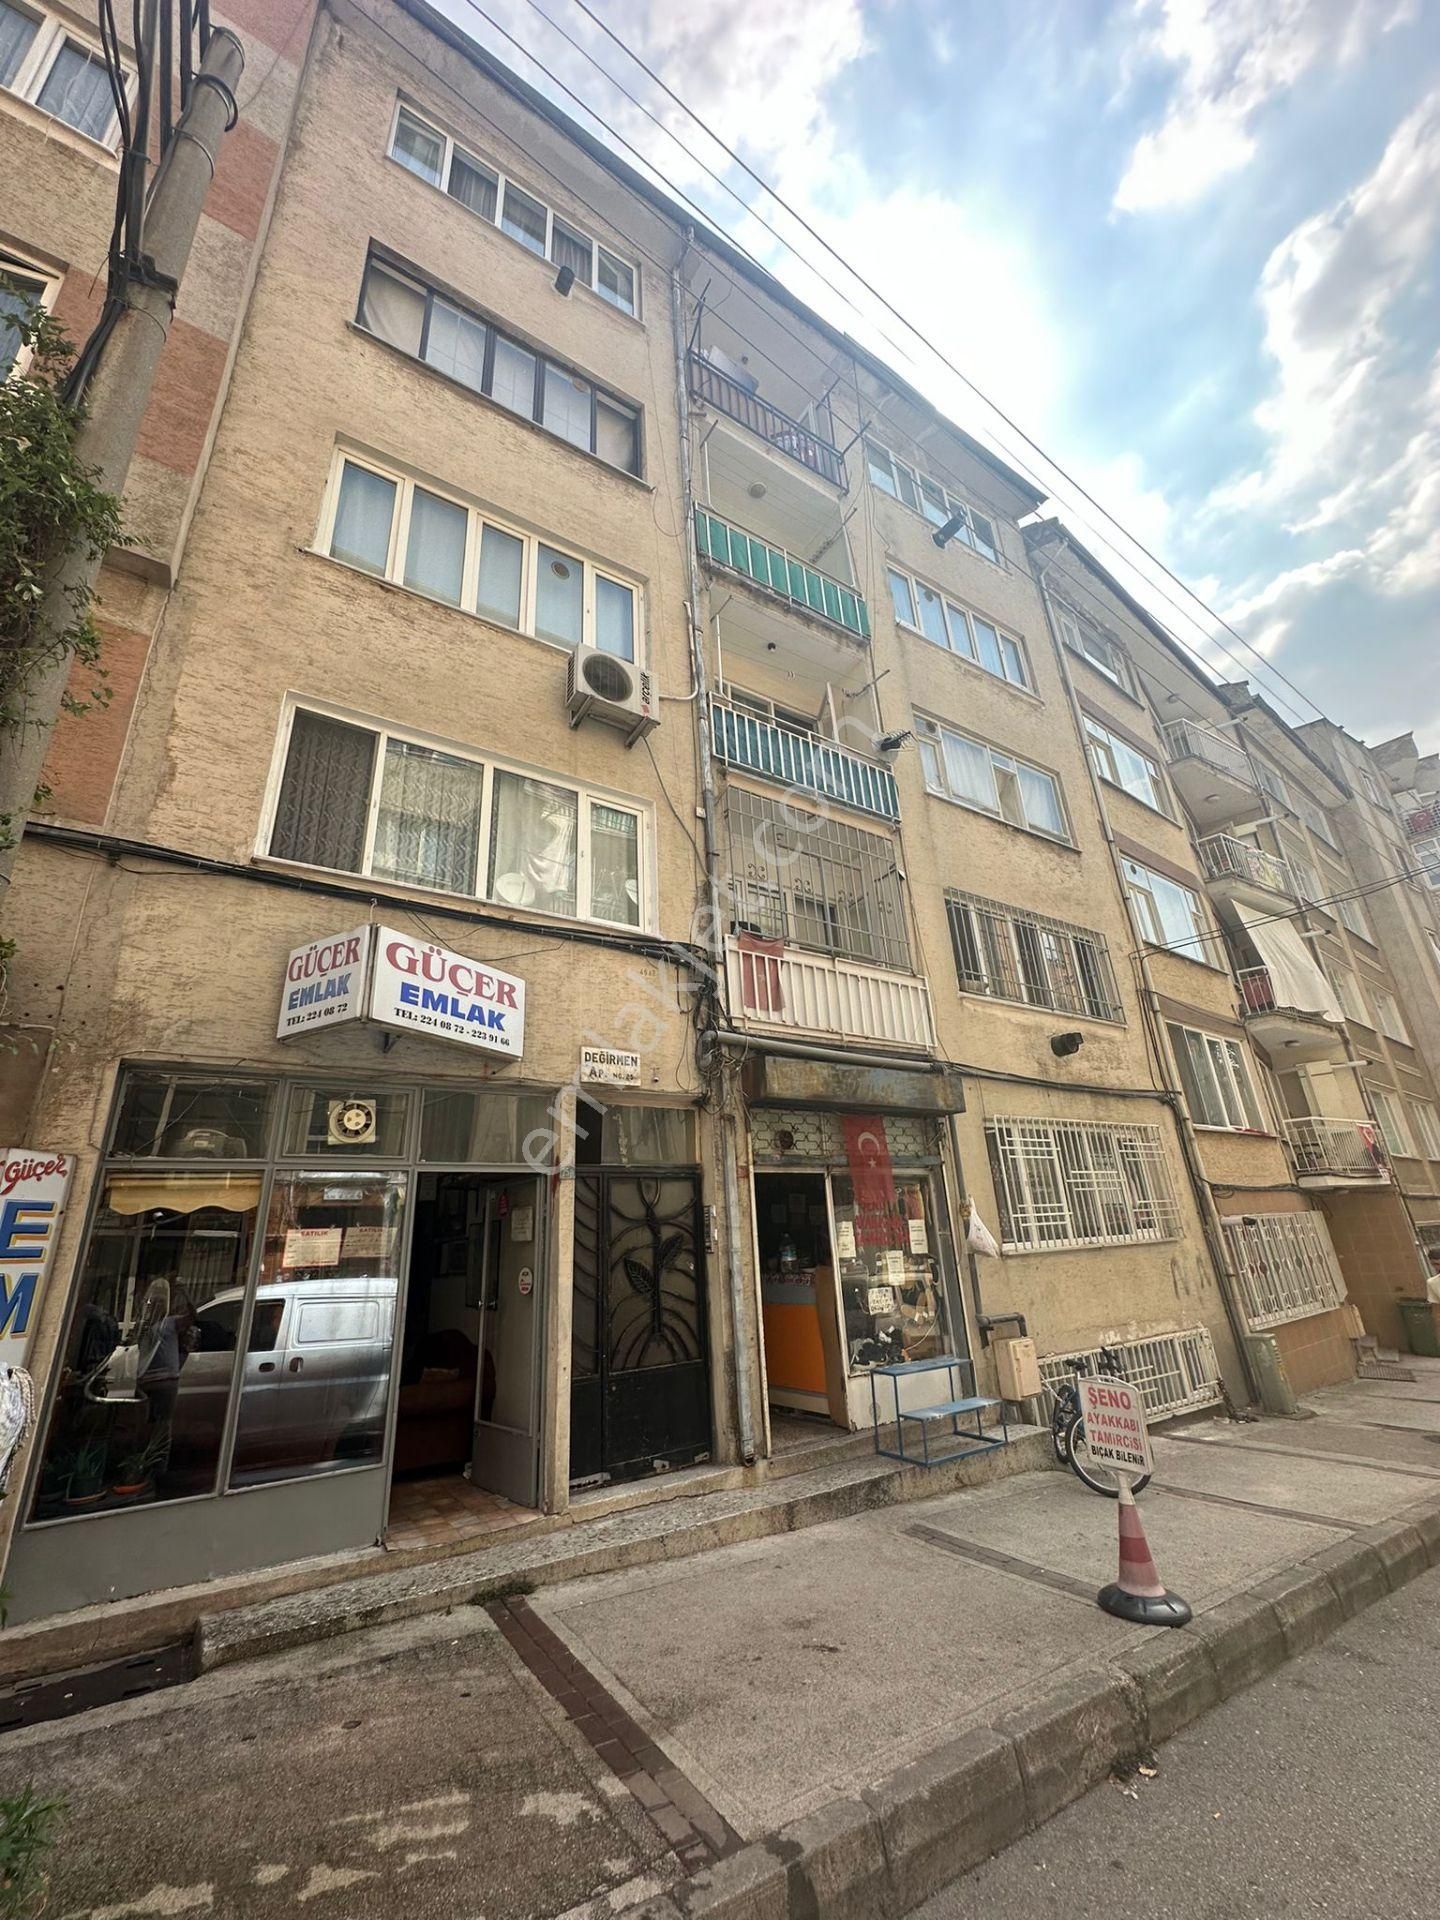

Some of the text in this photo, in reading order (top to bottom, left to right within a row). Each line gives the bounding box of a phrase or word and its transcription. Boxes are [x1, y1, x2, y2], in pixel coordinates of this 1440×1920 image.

[288, 936, 361, 982] GÜÇER
[386, 942, 519, 1009] GÜÇER
[287, 972, 352, 1011] EMLAK
[400, 981, 506, 1032] EMLAK
[287, 1003, 348, 1026] TEL: 224 08 72
[394, 1007, 418, 1021] TEL:
[420, 1014, 438, 1027] 224
[440, 1020, 452, 1031] 08
[454, 1024, 464, 1034] 72
[471, 1029, 487, 1040] 223
[488, 1034, 498, 1043] 91
[500, 1037, 510, 1046] 66
[584, 1050, 638, 1067] DEĞİRMEN
[1087, 1386, 1131, 1410] ŞENO
[1087, 1412, 1139, 1432] AYAKKABI
[1091, 1445, 1115, 1459] BIÇAK
